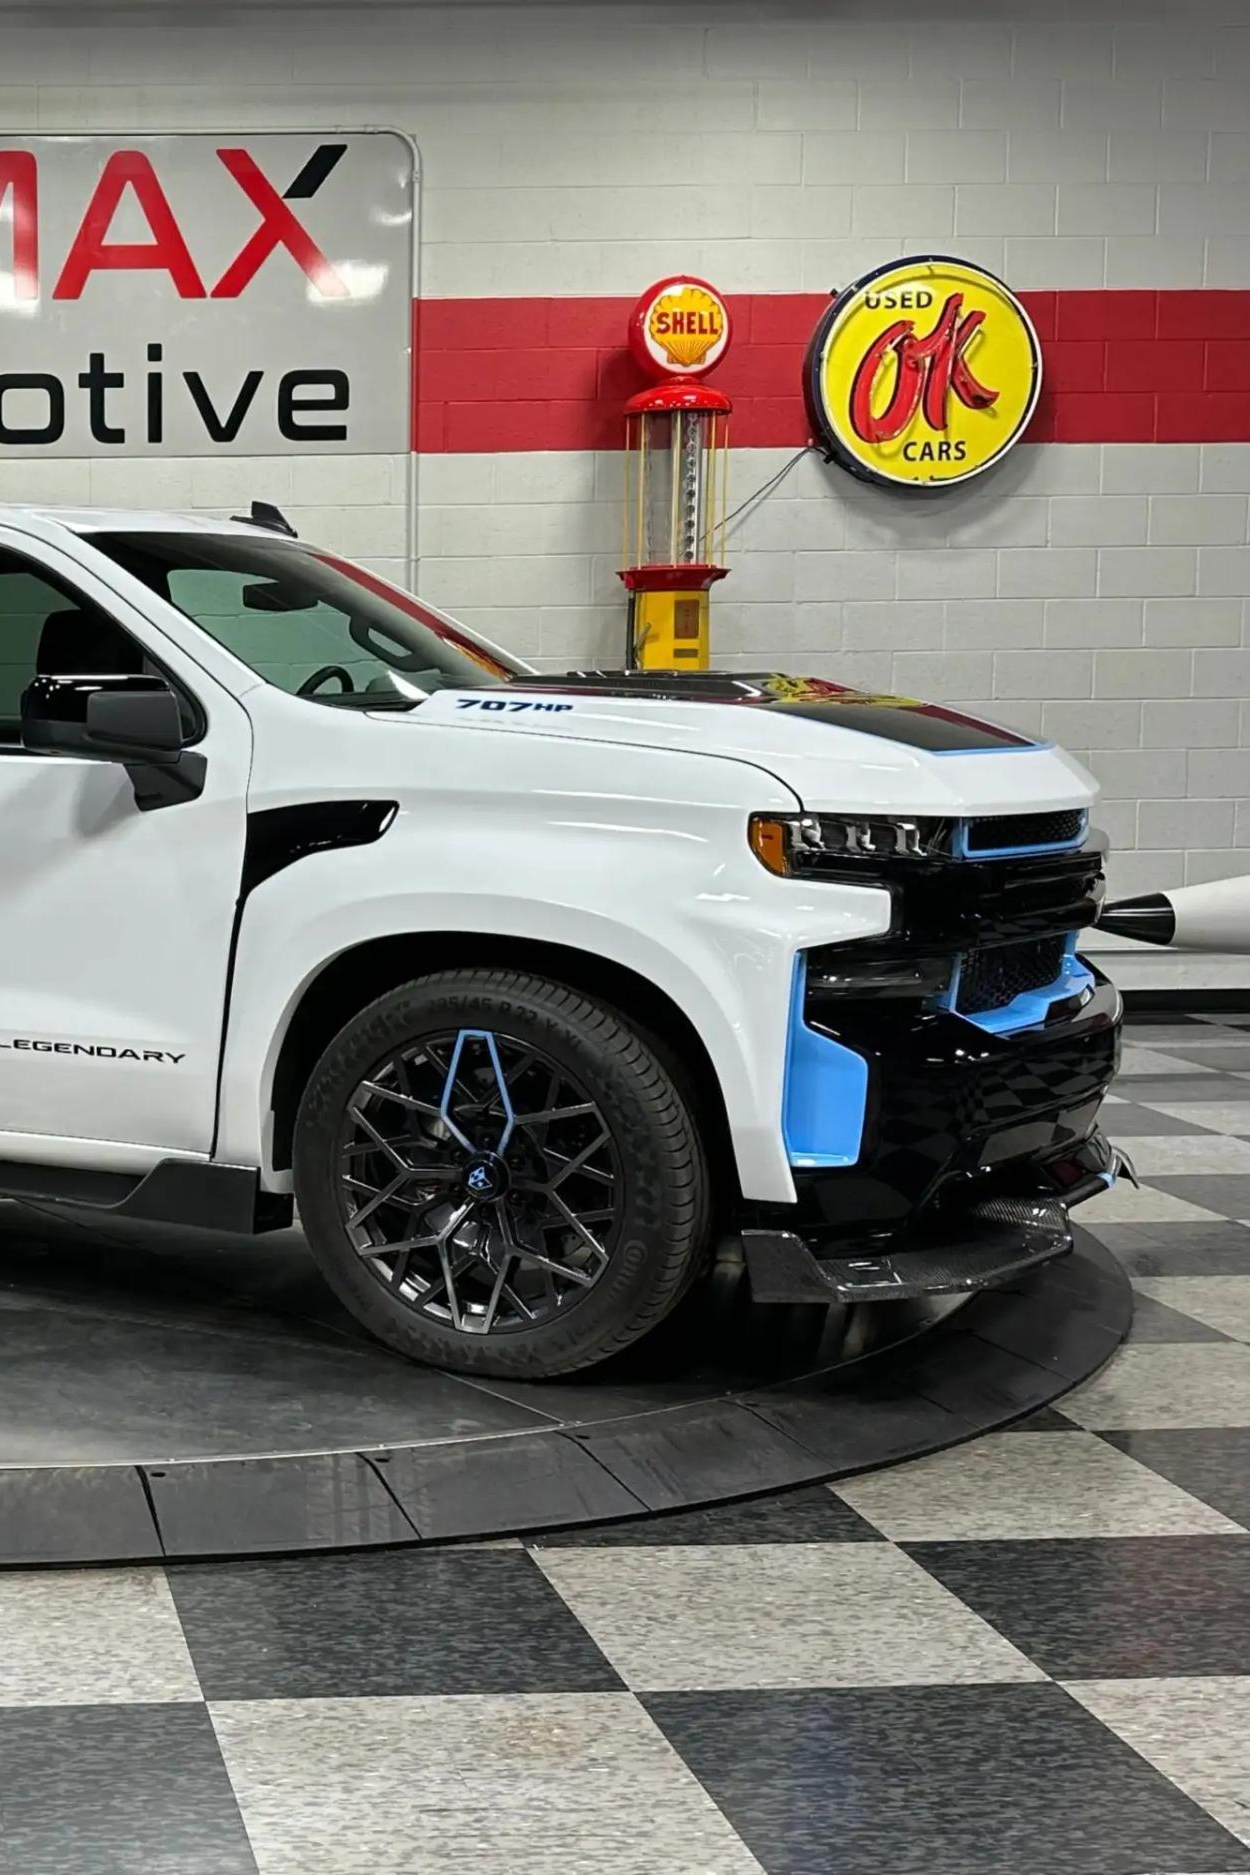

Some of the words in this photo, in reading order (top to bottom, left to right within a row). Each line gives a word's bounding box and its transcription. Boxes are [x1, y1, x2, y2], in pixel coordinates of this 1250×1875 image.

[865, 291, 933, 309] USED
[656, 311, 719, 335] SHELL
[849, 293, 1000, 443] OK
[903, 441, 966, 461] CARS
[456, 699, 573, 712] 707HP
